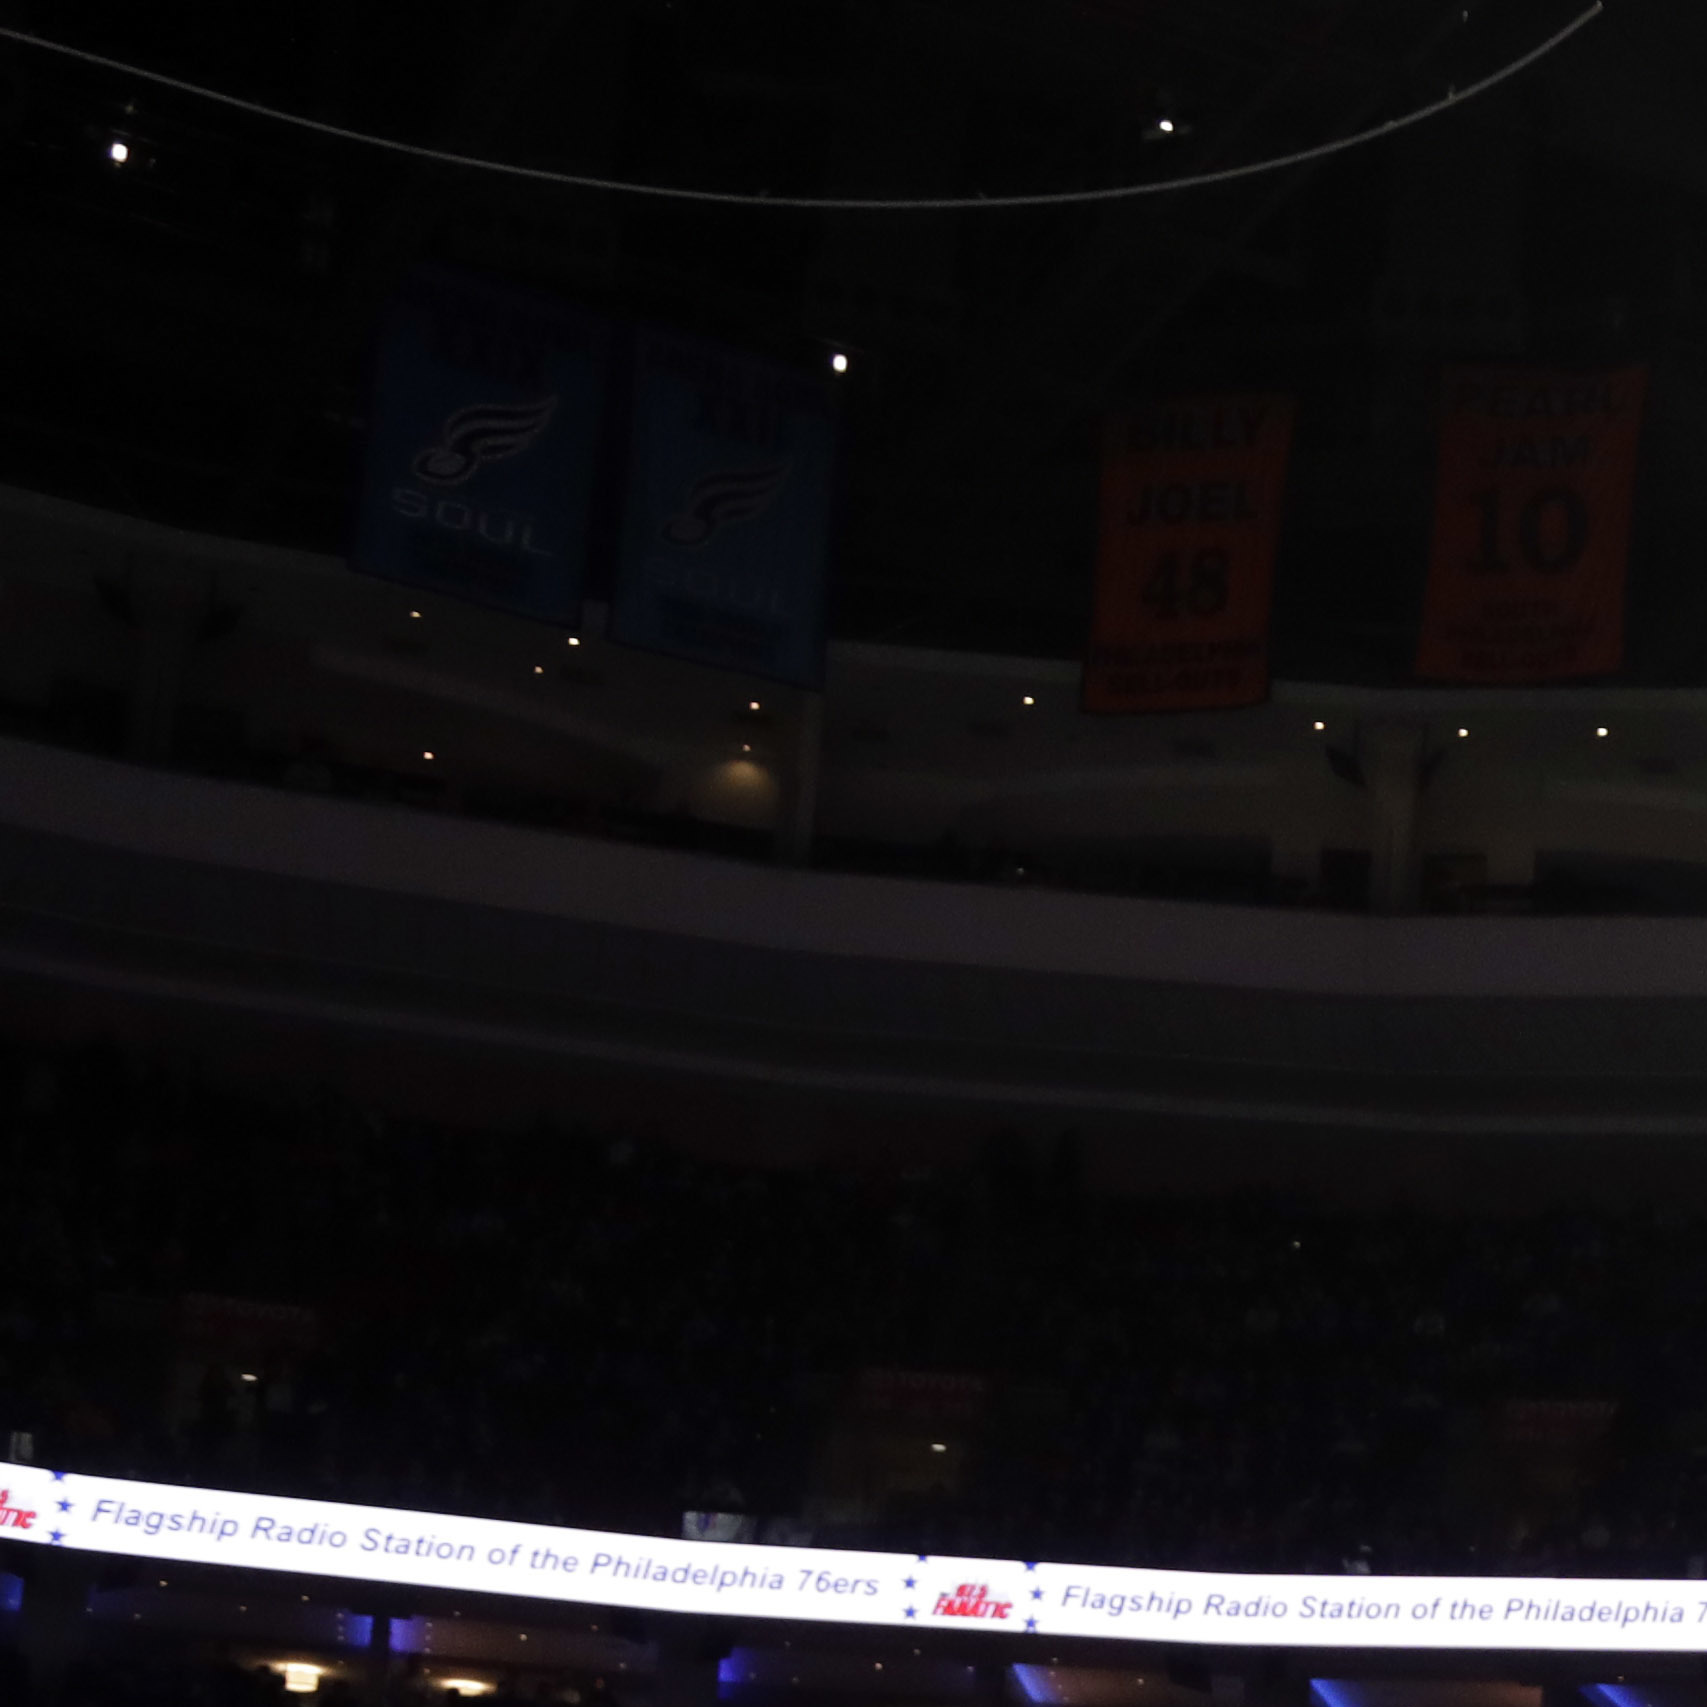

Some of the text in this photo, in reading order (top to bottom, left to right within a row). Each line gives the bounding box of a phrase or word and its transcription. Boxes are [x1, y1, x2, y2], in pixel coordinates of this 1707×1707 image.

[390, 485, 555, 556] SOUL
[1126, 480, 1258, 527] JOEL
[1465, 486, 1590, 575] 10
[1140, 548, 1229, 619] 48
[91, 1498, 878, 1596] Flagship Radio Station of the Philadelphia 76ers
[1062, 1584, 1192, 1619] Flagship
[1204, 1593, 1288, 1618] Radio
[1299, 1595, 1400, 1620] Station
[1411, 1597, 1442, 1620] of
[1449, 1599, 1494, 1621] the
[1504, 1597, 1685, 1628] Philadelphia
